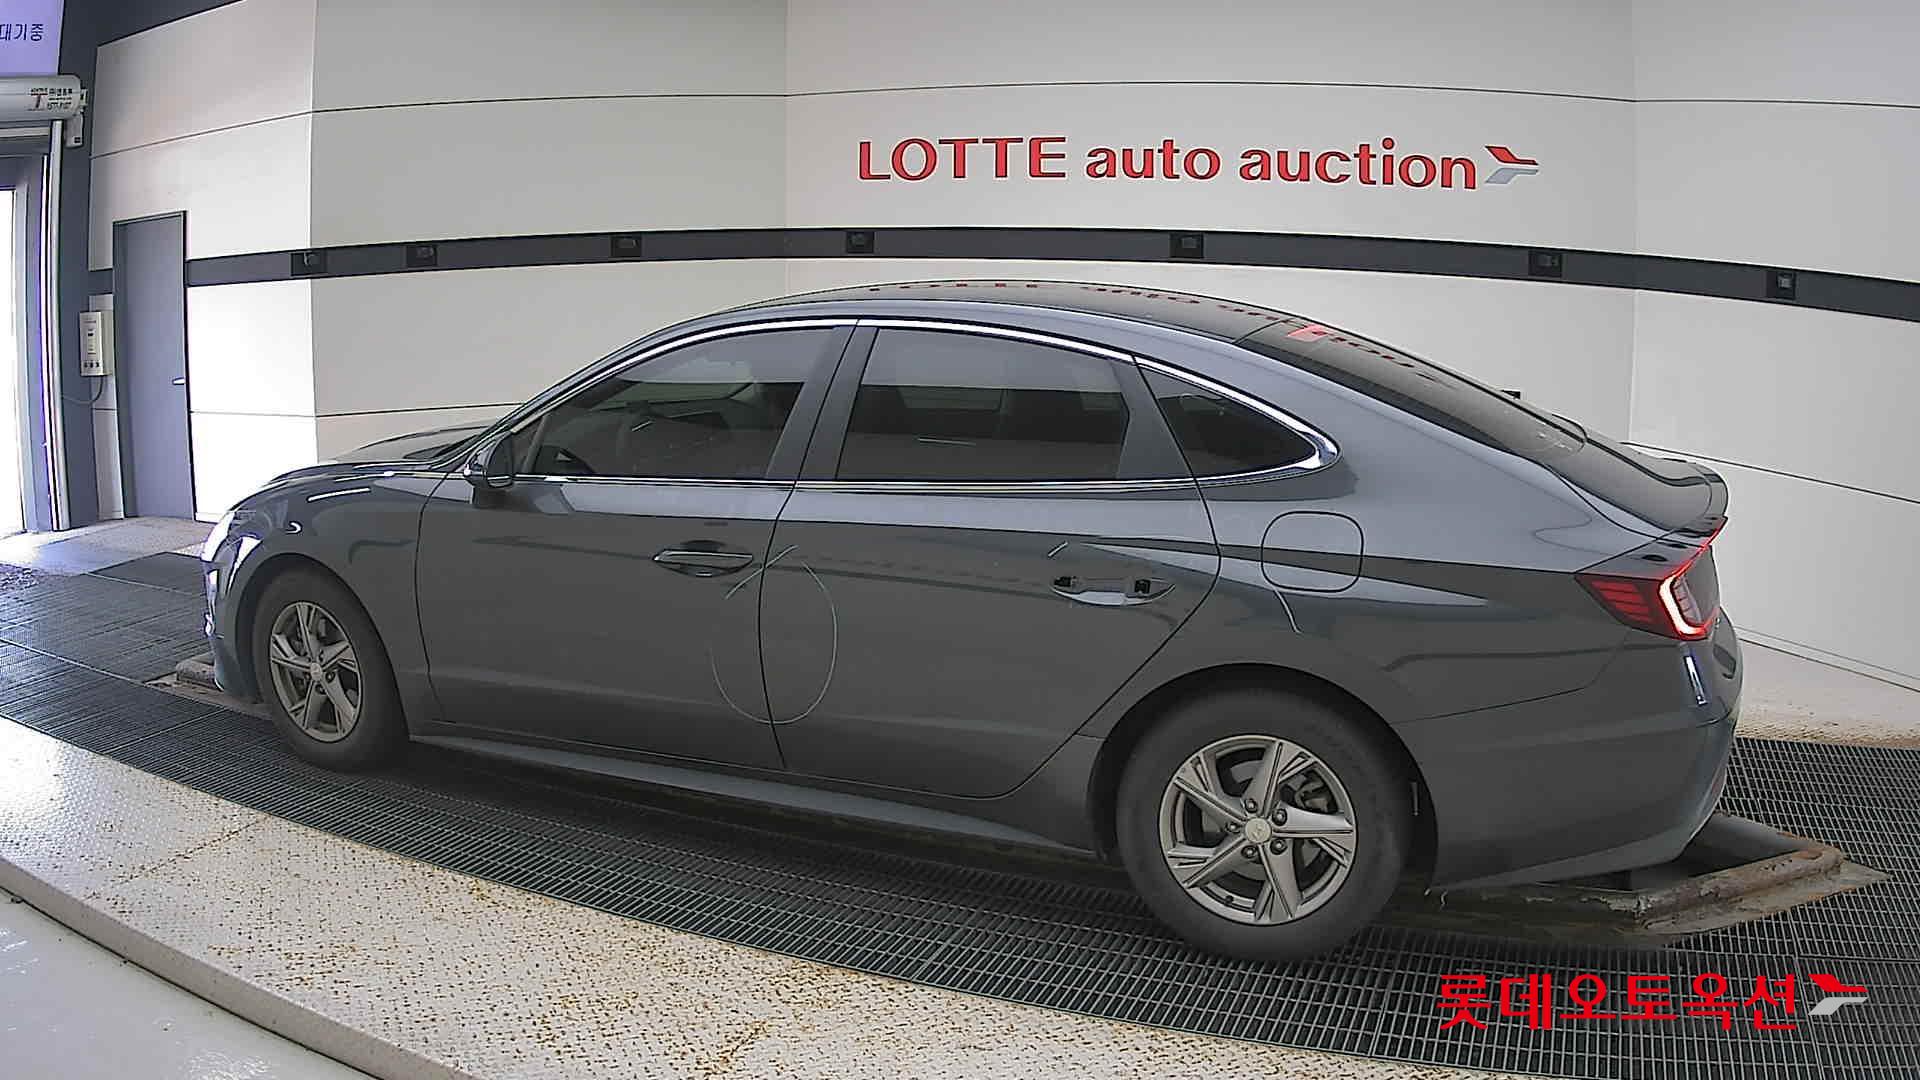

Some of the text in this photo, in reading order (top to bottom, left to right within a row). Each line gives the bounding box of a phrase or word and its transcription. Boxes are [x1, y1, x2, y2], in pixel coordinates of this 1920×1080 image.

[0, 23, 44, 42] 대기중
[858, 136, 1478, 190] LOTTE auto auction
